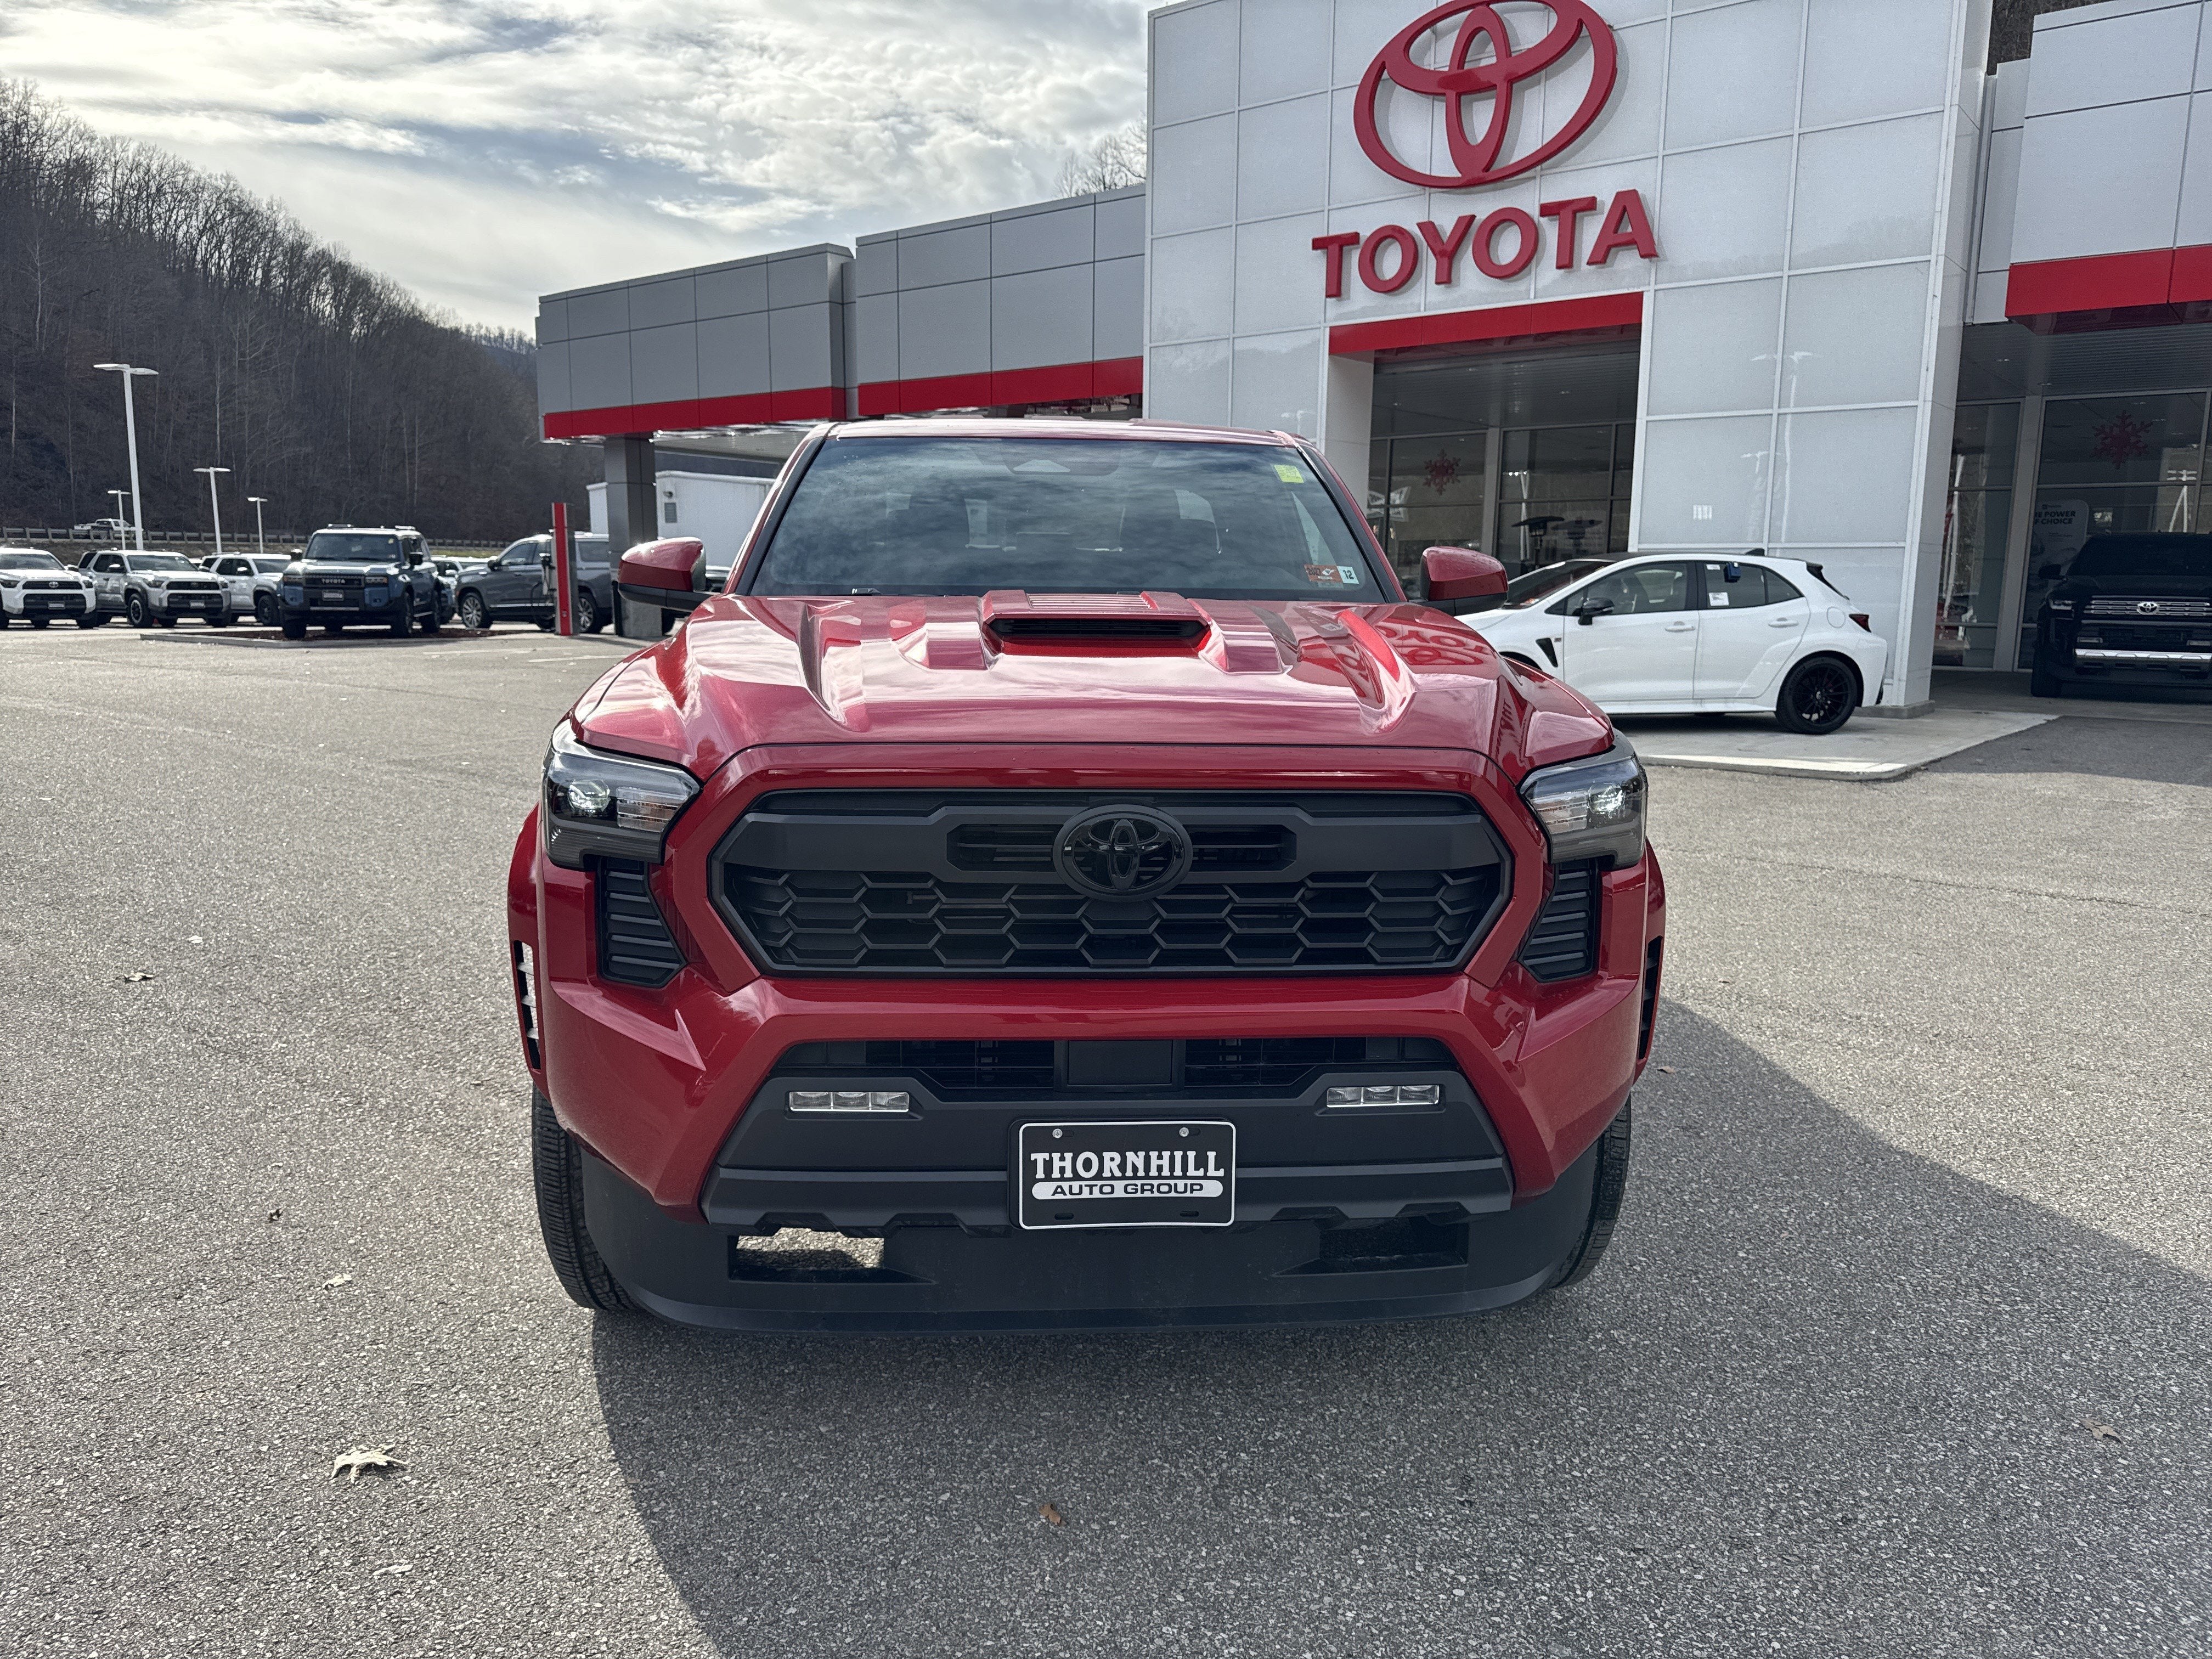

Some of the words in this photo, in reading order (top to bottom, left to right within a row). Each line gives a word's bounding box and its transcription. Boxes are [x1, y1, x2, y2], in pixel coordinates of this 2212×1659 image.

[1312, 189, 1659, 298] TOYOTA
[1342, 569, 1355, 579] 12
[1030, 1150, 1224, 1179] THORNHILL
[1051, 1183, 1115, 1197] AUTO
[1124, 1183, 1204, 1195] GROUP
